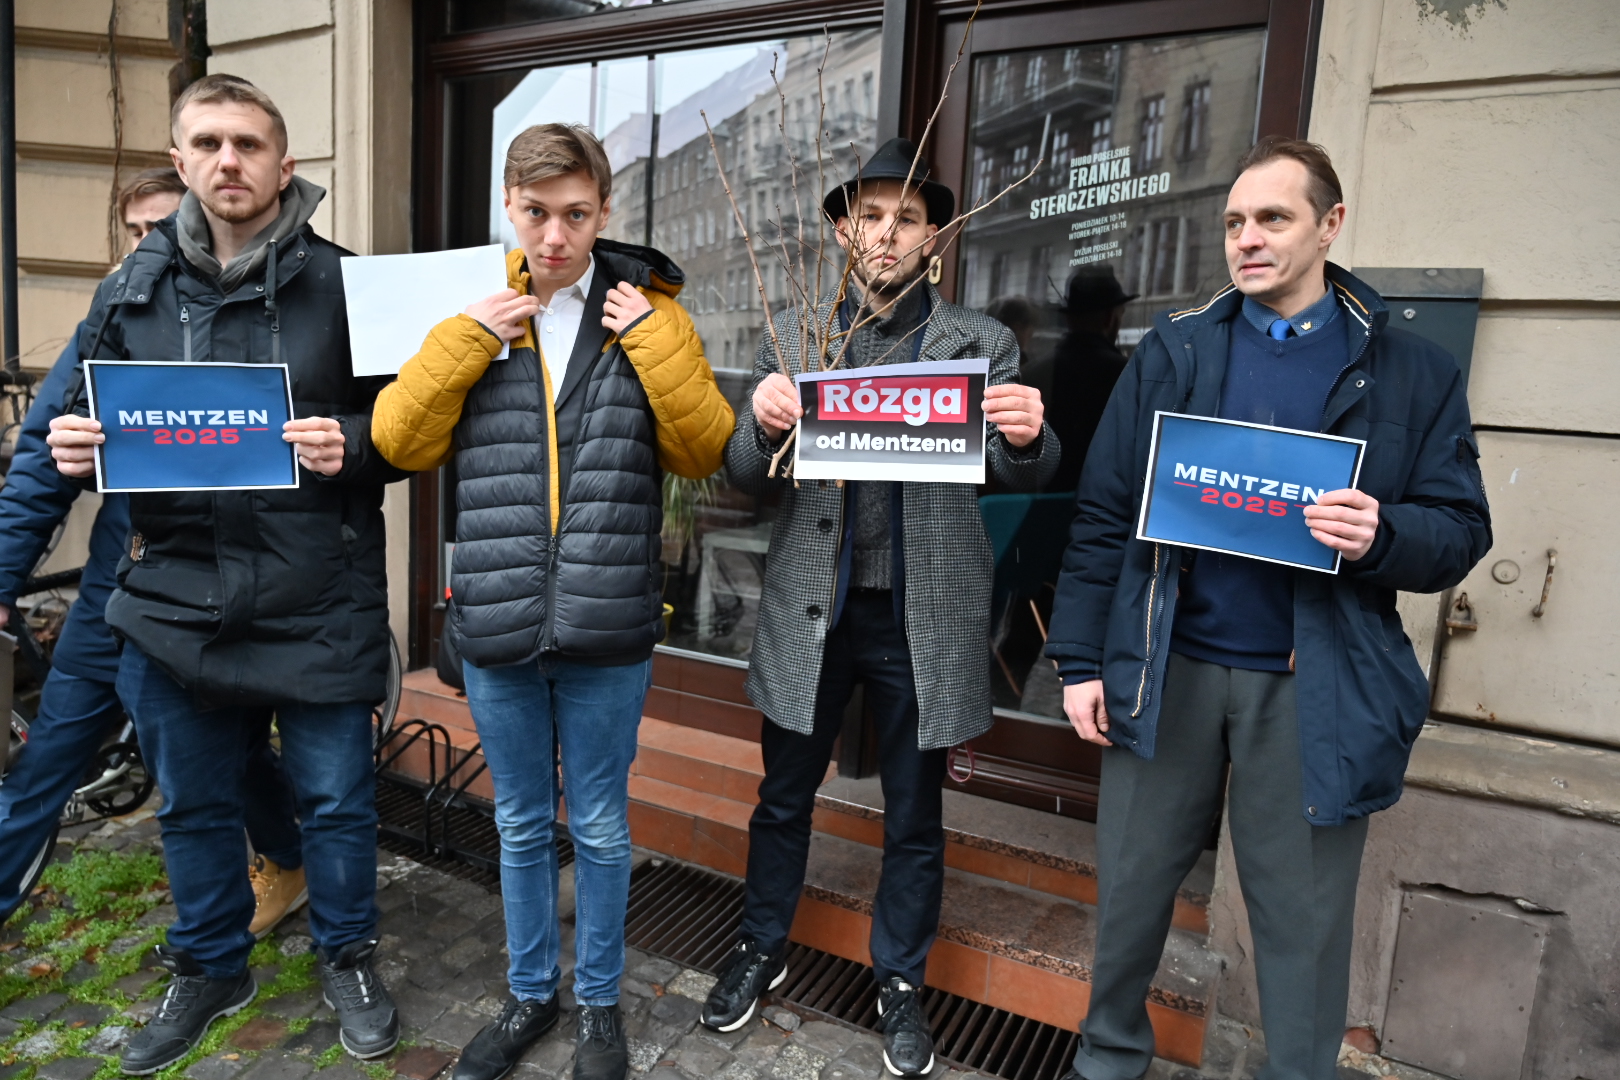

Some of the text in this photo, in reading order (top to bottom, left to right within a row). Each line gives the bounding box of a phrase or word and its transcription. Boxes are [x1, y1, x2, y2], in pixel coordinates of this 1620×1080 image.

[1070, 146, 1131, 168] BIURO POSELSKIE
[1069, 157, 1131, 190] FRANKA
[1029, 172, 1171, 220] STERCZEWSKIEGO
[118, 409, 268, 425] MENTZEN
[823, 379, 962, 426] Rózga
[153, 428, 240, 445] 2025
[815, 431, 966, 453] od Mentzena
[1174, 462, 1325, 504] MENTZEN
[1200, 487, 1288, 517] 2025
